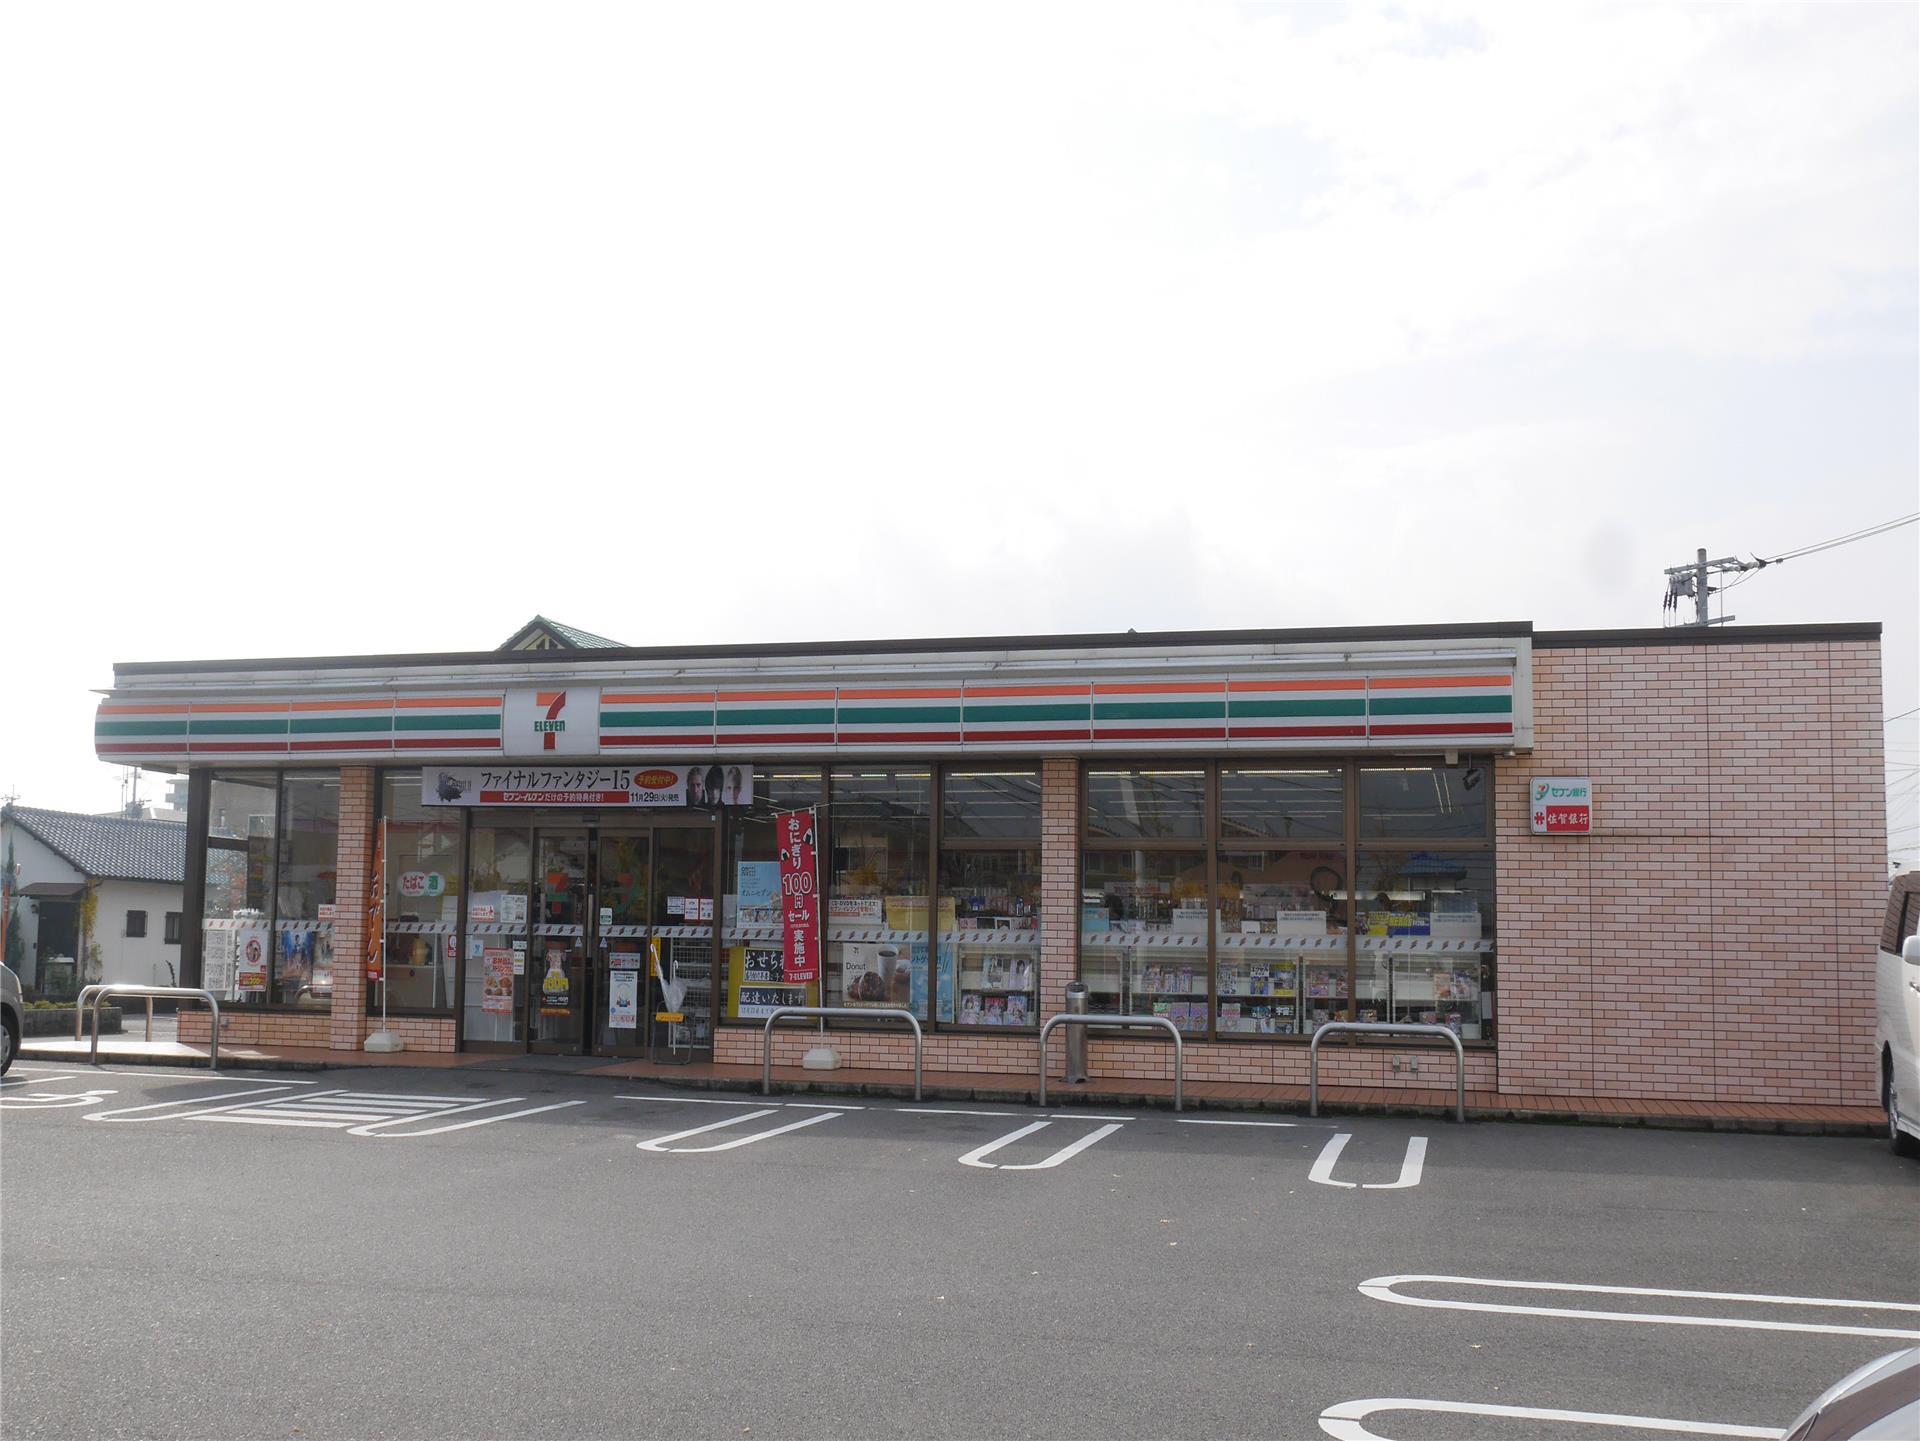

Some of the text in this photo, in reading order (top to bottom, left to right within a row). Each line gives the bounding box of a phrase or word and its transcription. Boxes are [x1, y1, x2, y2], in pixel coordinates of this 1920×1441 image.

[536, 690, 567, 749] 7
[480, 768, 631, 790] ファイナルファンタジー15
[1551, 787, 1588, 798] セブン銀行
[1547, 812, 1590, 825] 佐賀銀行
[787, 818, 802, 870] おにぎり
[402, 875, 425, 890] たばこ
[788, 908, 810, 923] セール
[793, 929, 806, 968] 実施中
[740, 991, 805, 1005] 配達いたします
